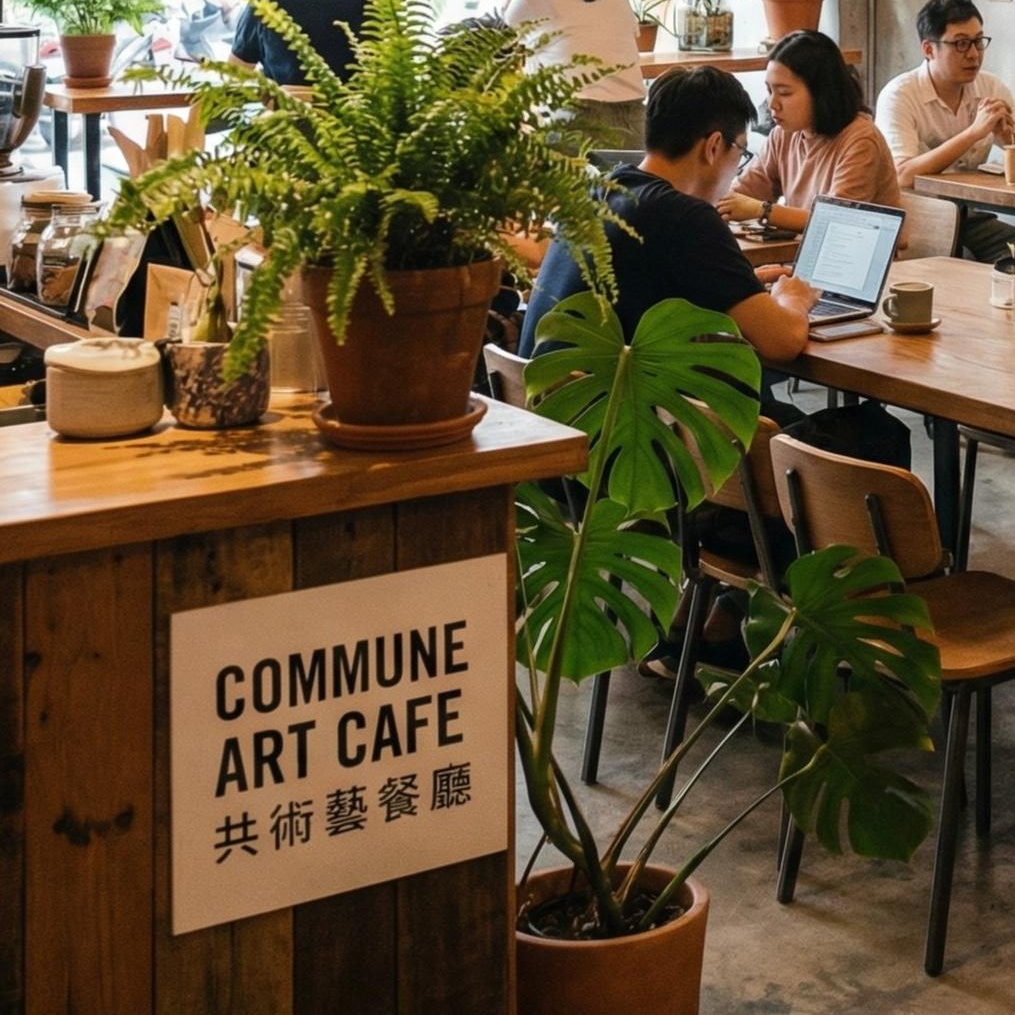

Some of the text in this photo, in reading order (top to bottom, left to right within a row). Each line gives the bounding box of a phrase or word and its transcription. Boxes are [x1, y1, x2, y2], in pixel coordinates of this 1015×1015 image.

[216, 620, 469, 721] COMMUNE
[215, 688, 464, 798] ART CAFE
[214, 762, 472, 865] 共術藝餐廳
